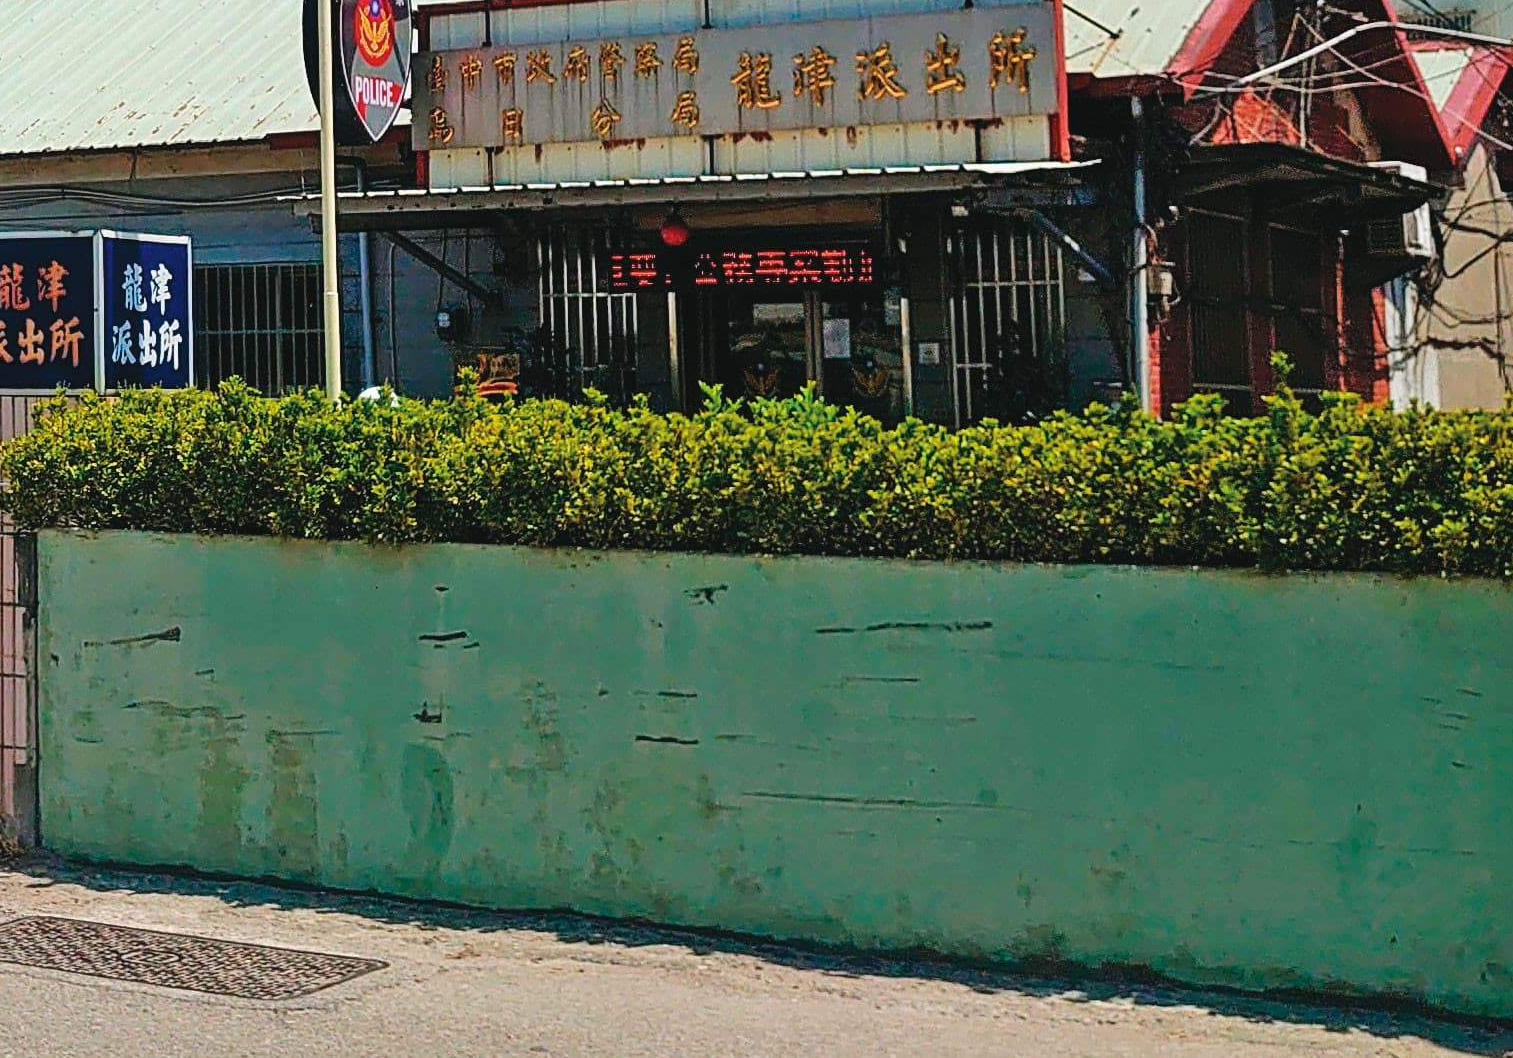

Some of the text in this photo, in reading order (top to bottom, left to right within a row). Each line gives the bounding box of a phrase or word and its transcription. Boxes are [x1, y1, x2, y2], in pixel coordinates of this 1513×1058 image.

[355, 76, 394, 108] POLICE
[731, 26, 1037, 110] 龍津派出所
[122, 262, 173, 316] 龍津
[112, 319, 183, 371] 派出所
